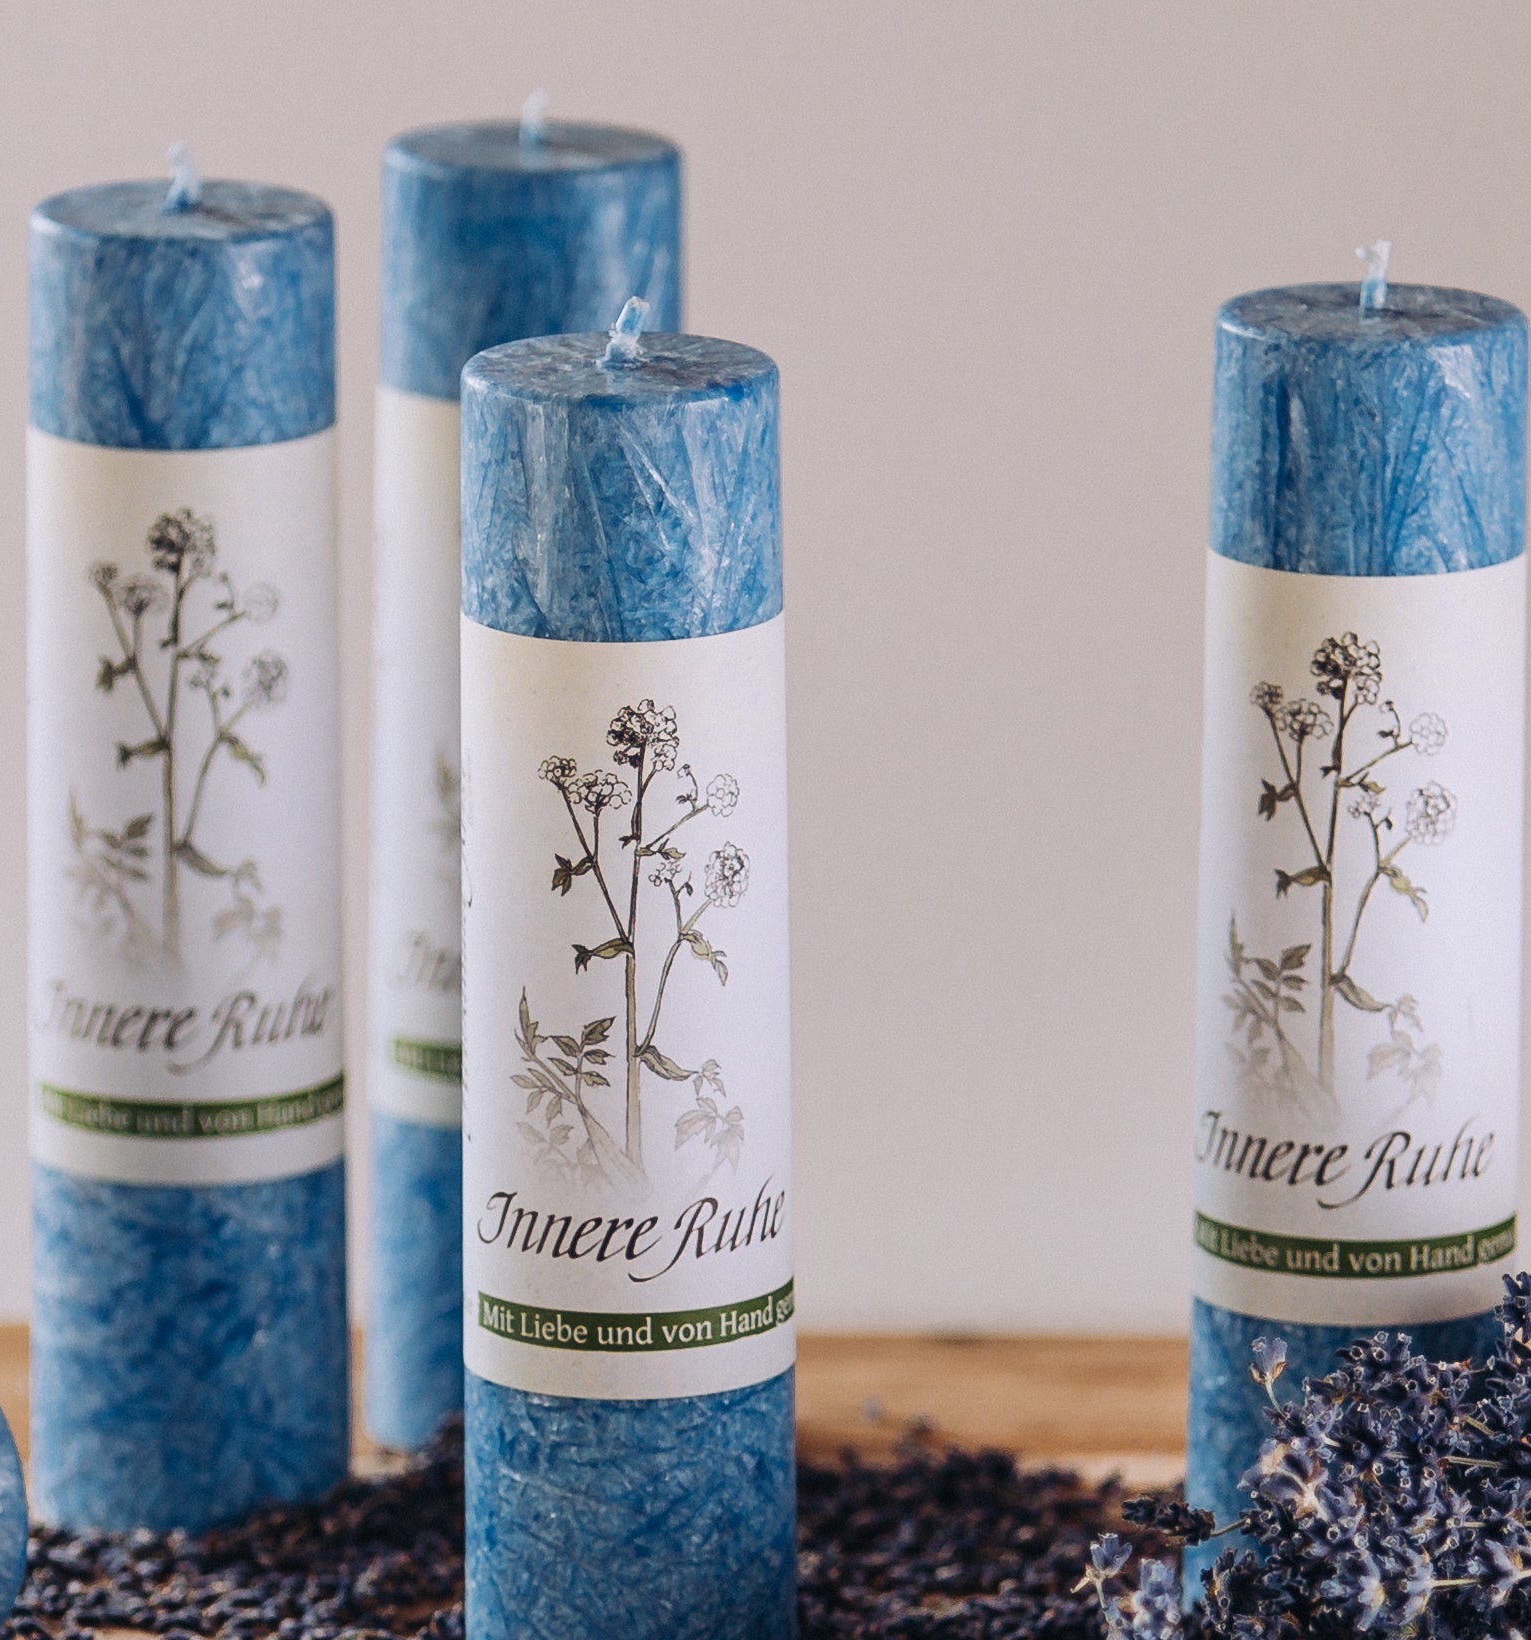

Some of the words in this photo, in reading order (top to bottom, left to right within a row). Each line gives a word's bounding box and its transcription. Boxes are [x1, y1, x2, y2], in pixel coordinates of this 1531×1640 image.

[1194, 1110, 1351, 1186] Innere
[1316, 1115, 1495, 1210] Ruhe
[477, 1191, 662, 1262] Innere
[628, 1175, 785, 1283] Ruhe
[1285, 1243, 1340, 1272] und
[1348, 1252, 1402, 1274] von
[1410, 1234, 1475, 1270] Hand
[482, 1301, 514, 1334] Mit
[520, 1313, 588, 1344] Liebe
[597, 1317, 653, 1345] und
[661, 1318, 713, 1343] von
[720, 1295, 773, 1337] Hand
